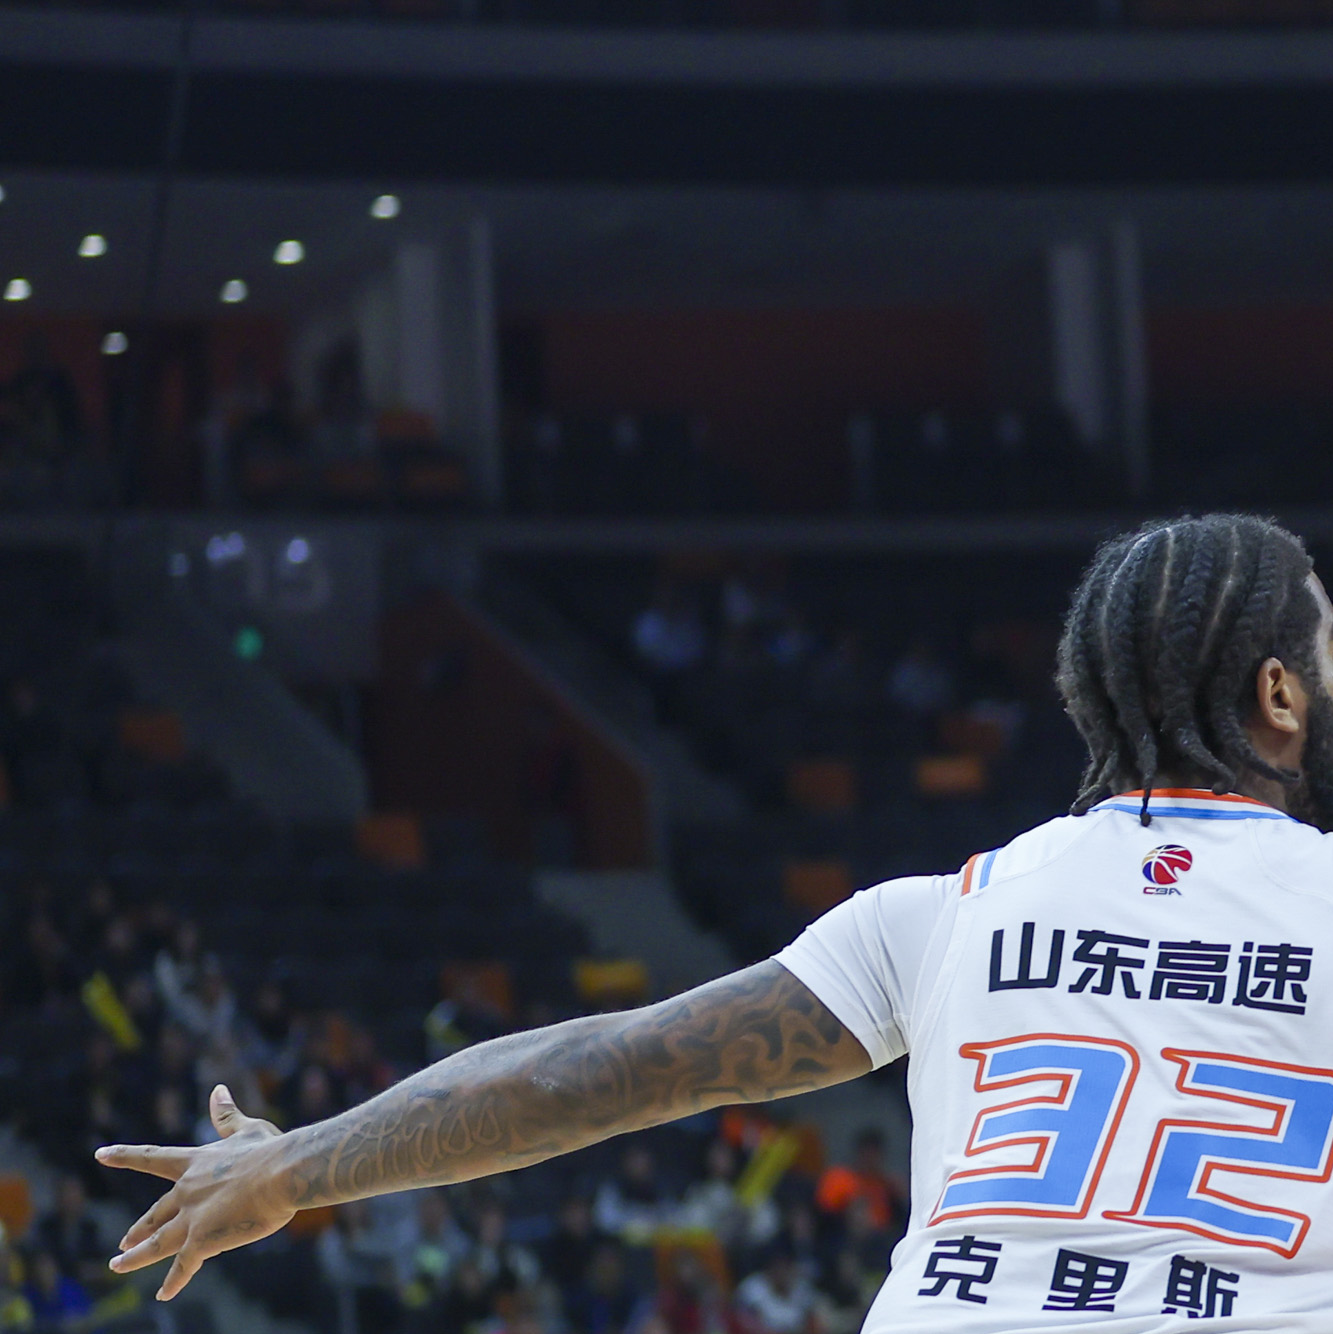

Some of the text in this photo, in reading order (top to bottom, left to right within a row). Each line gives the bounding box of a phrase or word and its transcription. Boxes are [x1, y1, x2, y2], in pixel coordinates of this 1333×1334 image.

[1143, 886, 1182, 896] CBA
[988, 922, 1313, 1015] 山东高速
[918, 1235, 1240, 1319] 克里斯
